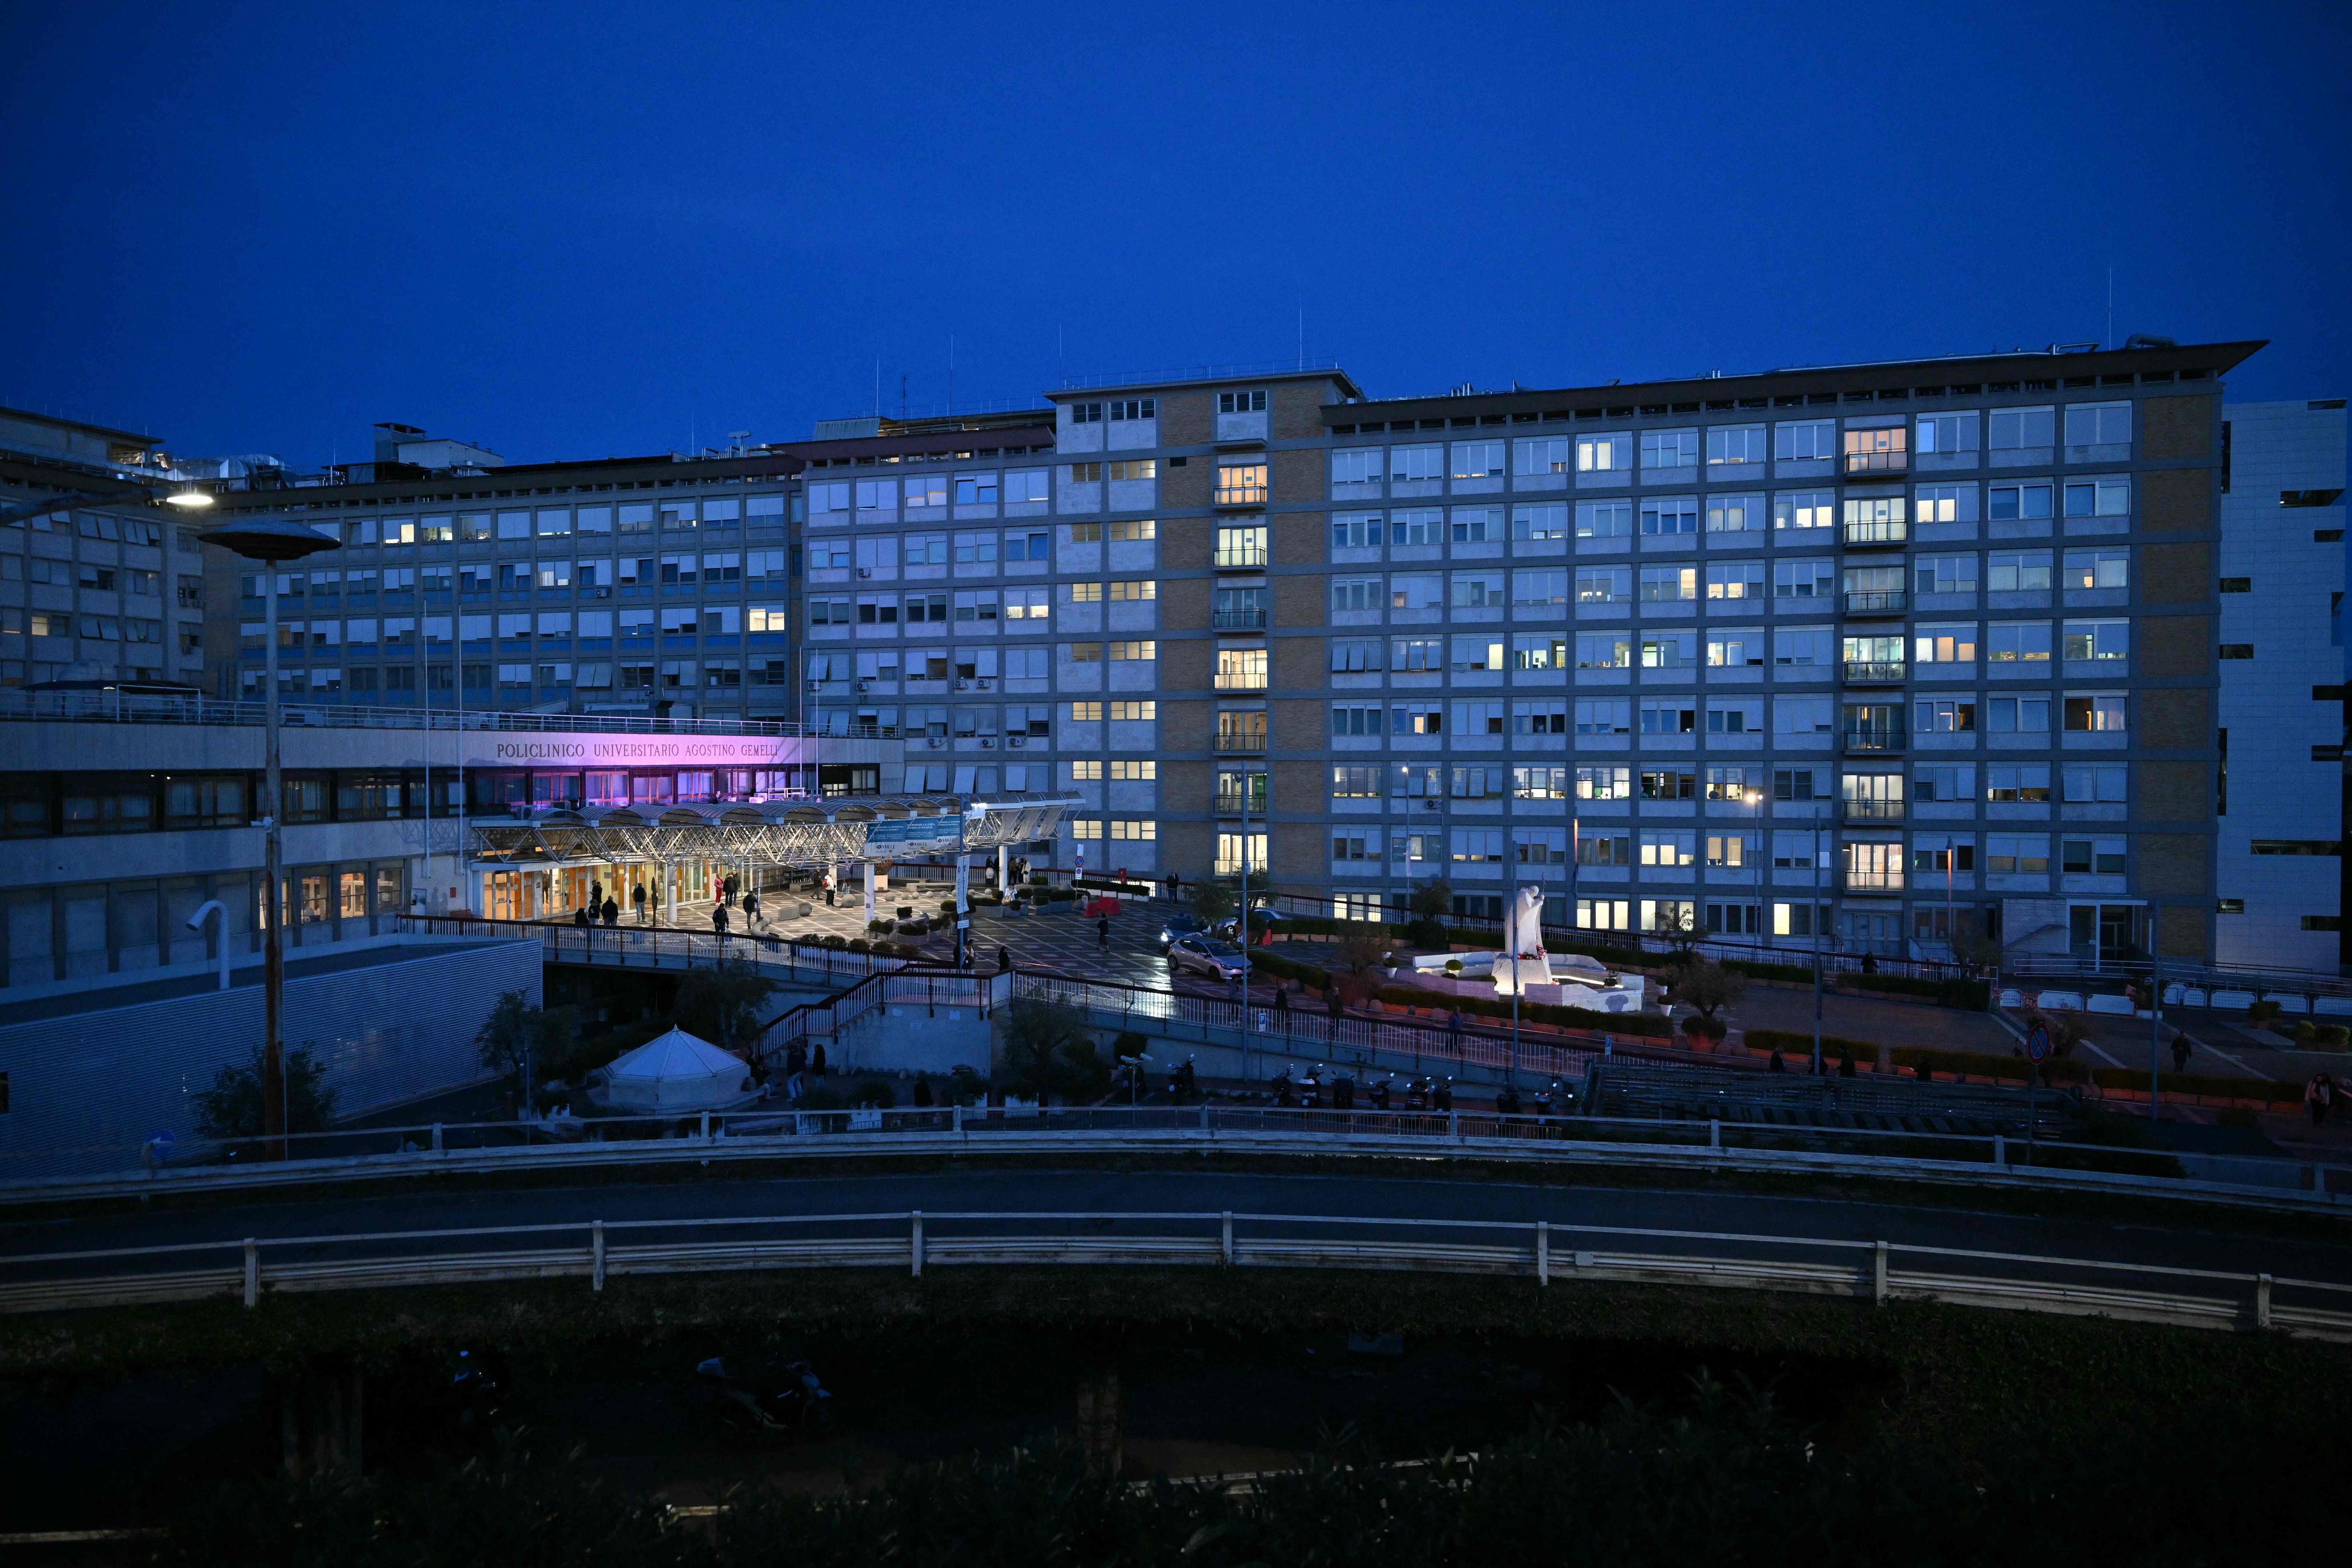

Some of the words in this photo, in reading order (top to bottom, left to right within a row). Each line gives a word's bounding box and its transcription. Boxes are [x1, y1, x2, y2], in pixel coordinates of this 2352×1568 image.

[497, 744, 584, 758] POLICLINICO
[594, 744, 679, 757] UNIVERSITARIO
[685, 744, 735, 756] AGOSTINO
[741, 744, 778, 756] GEMELLI
